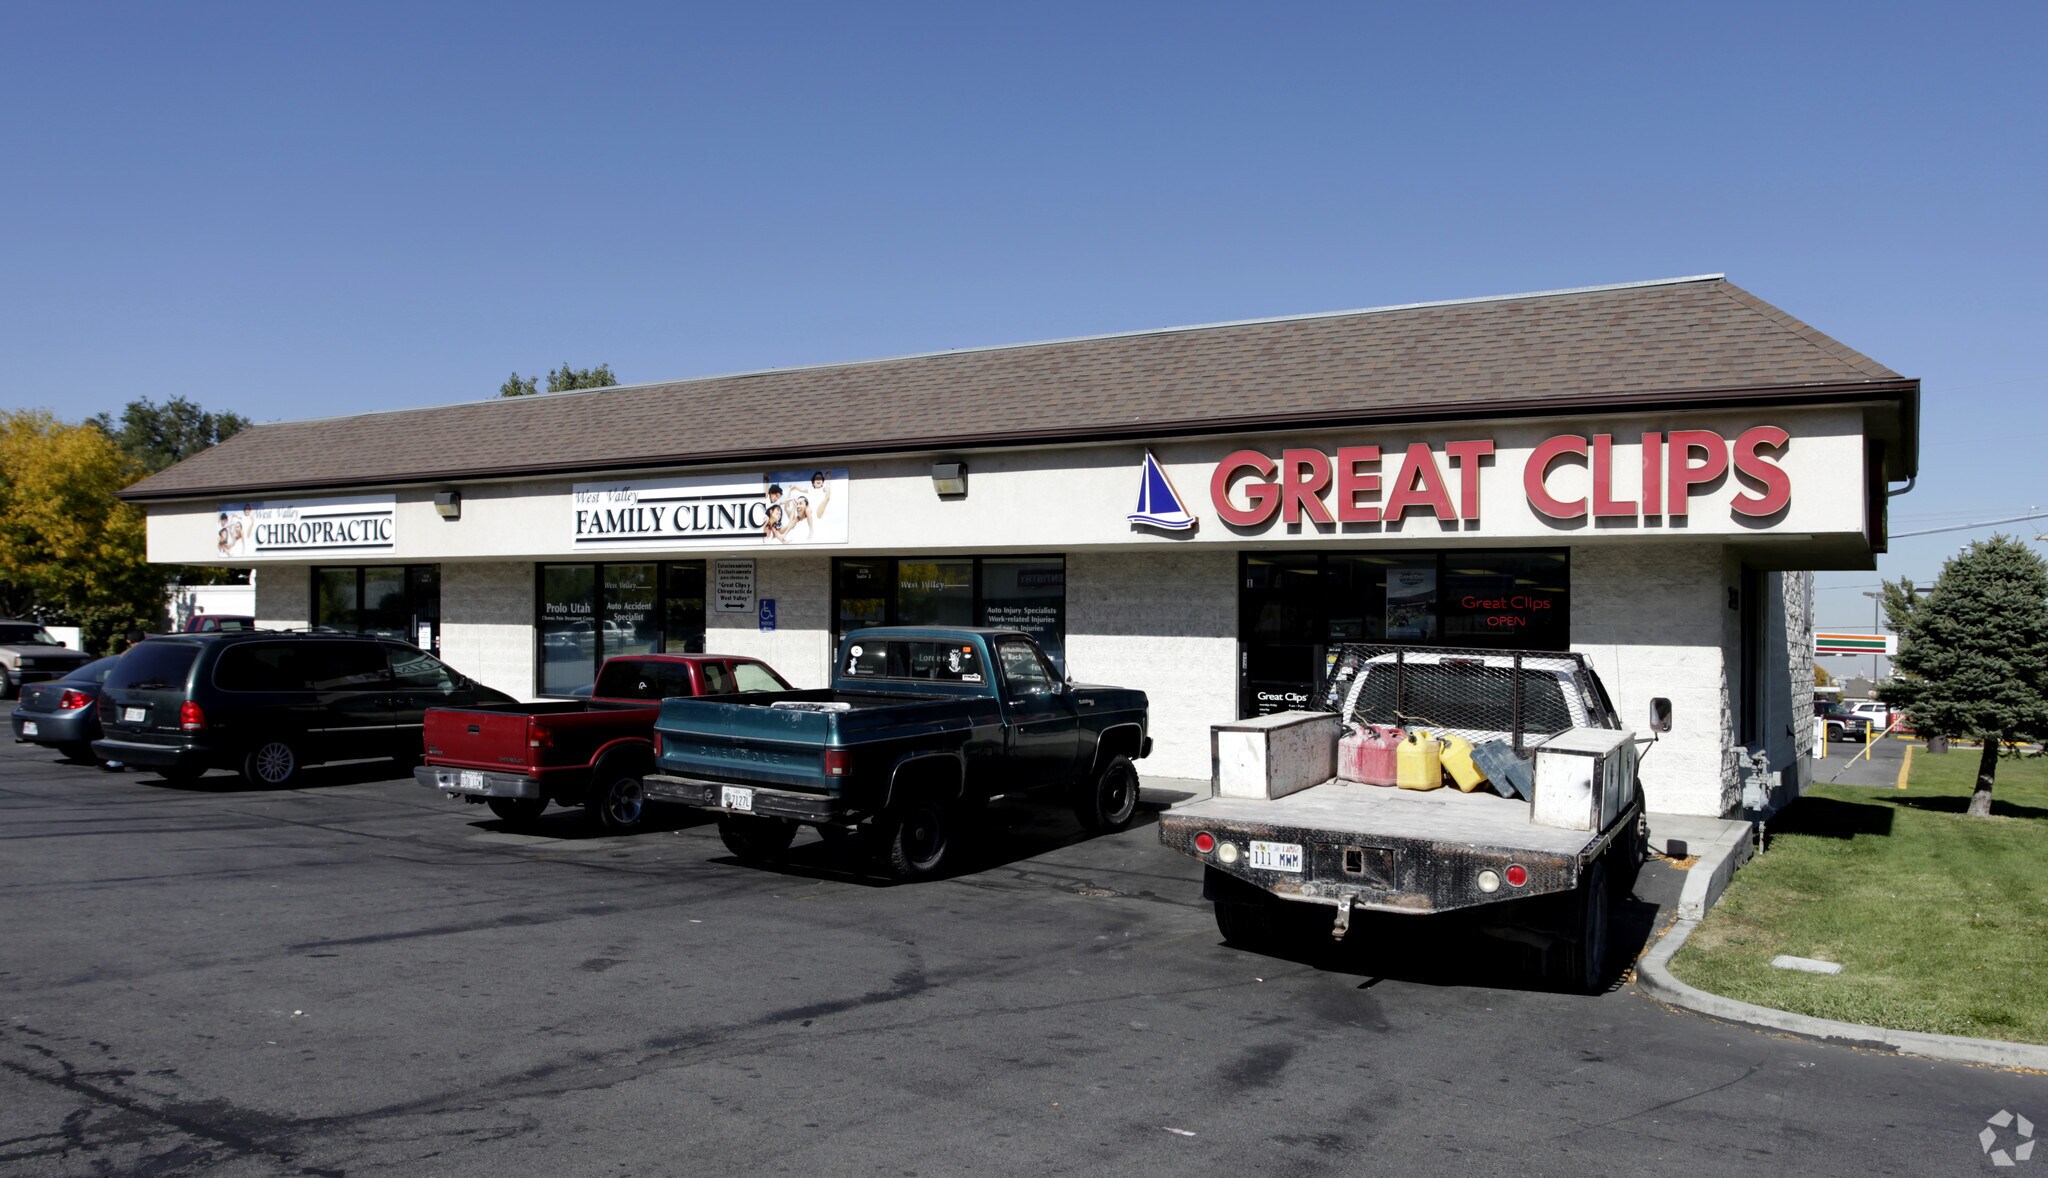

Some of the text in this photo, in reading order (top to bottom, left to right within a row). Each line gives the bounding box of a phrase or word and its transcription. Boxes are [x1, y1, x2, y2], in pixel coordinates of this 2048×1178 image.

[1210, 425, 1791, 526] GREAT CLIPS
[575, 486, 639, 505] West Valley
[255, 505, 299, 521] West Valley
[576, 501, 767, 534] FAMILY CLINIC
[255, 518, 393, 545] CHIROPRACTIC
[605, 581, 637, 592] West Valley
[900, 580, 945, 591] West Valley
[546, 602, 591, 614] Prolo Utah
[606, 602, 652, 610] Auto Accident
[1461, 595, 1551, 612] Great Clips
[1003, 606, 1022, 616] Injury
[1023, 606, 1057, 615] Specialists
[613, 612, 644, 622] Specialist
[988, 615, 1055, 624] Work-related Injuries
[1486, 616, 1526, 626] OPEN
[1020, 624, 1044, 633] Injuries
[1257, 691, 1307, 704] Great Clips
